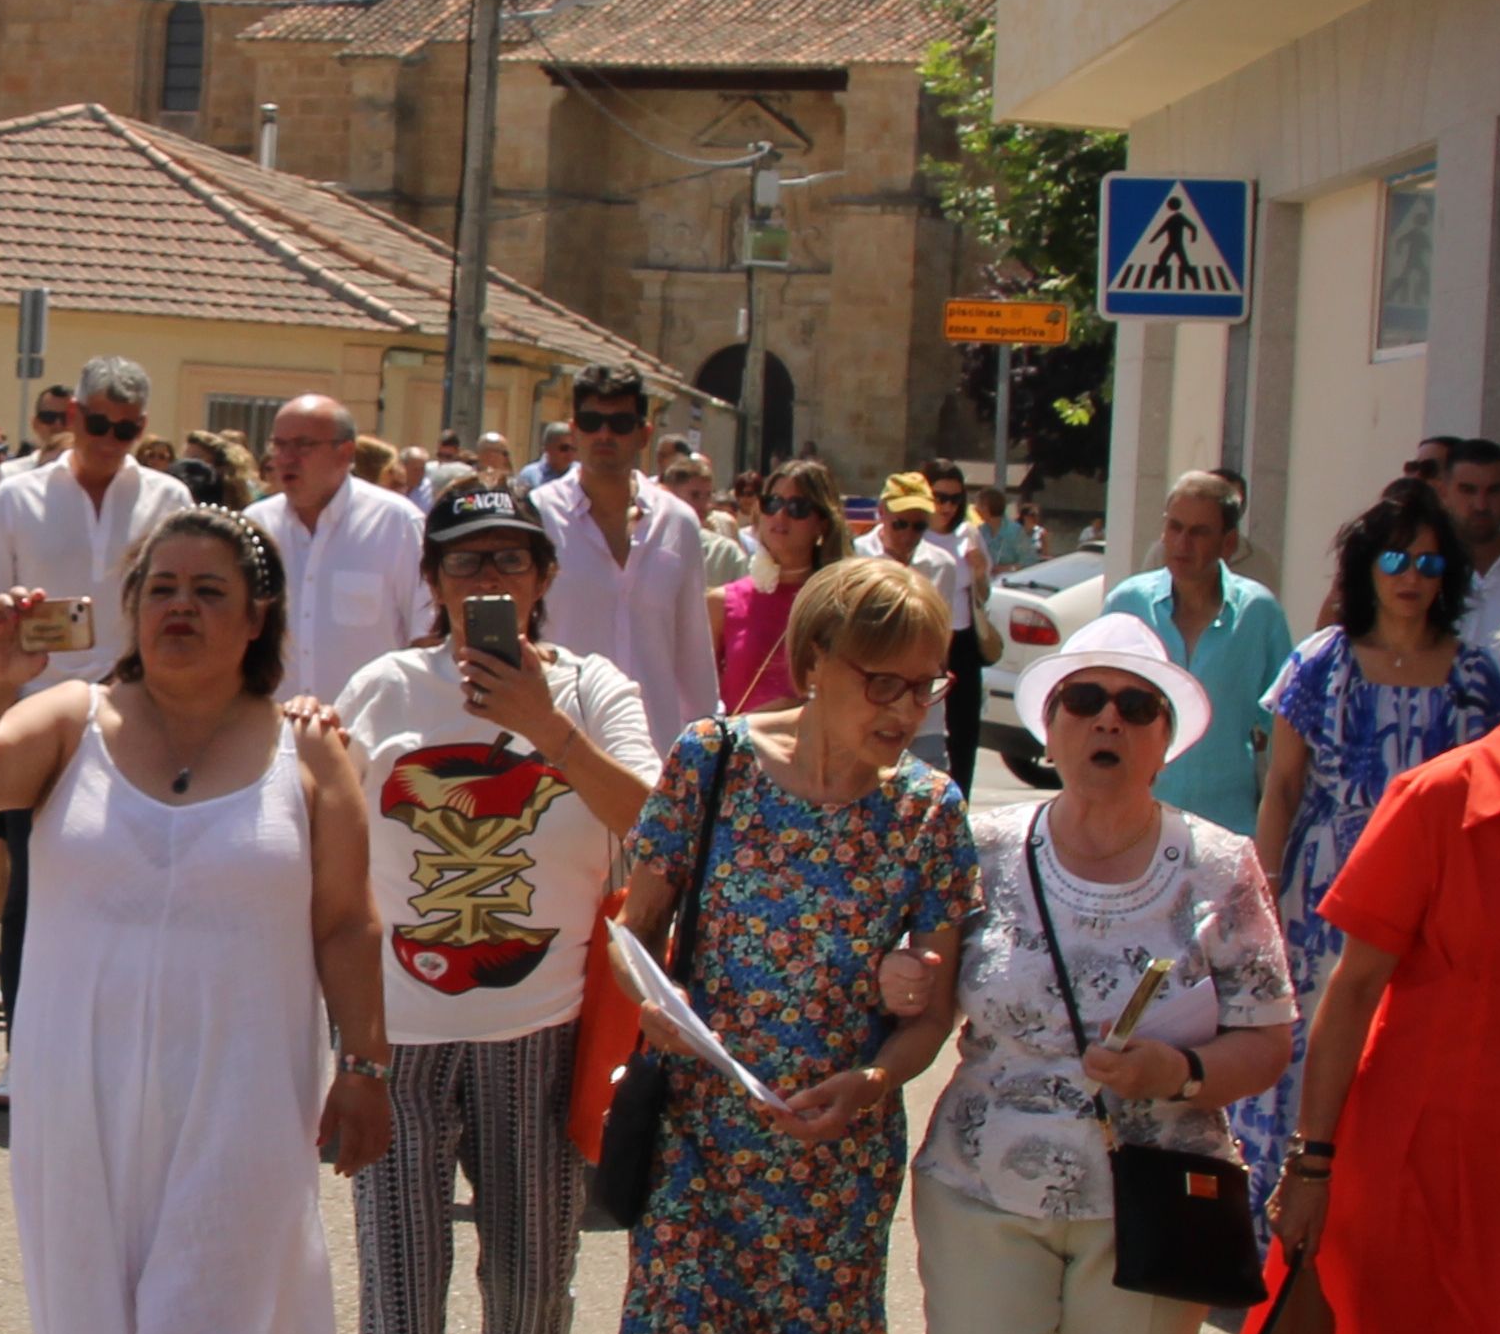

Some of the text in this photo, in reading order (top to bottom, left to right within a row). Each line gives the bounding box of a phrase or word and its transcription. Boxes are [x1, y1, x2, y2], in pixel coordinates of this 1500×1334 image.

[948, 307, 1001, 318] piscinas
[948, 325, 1046, 338] zona deportiva
